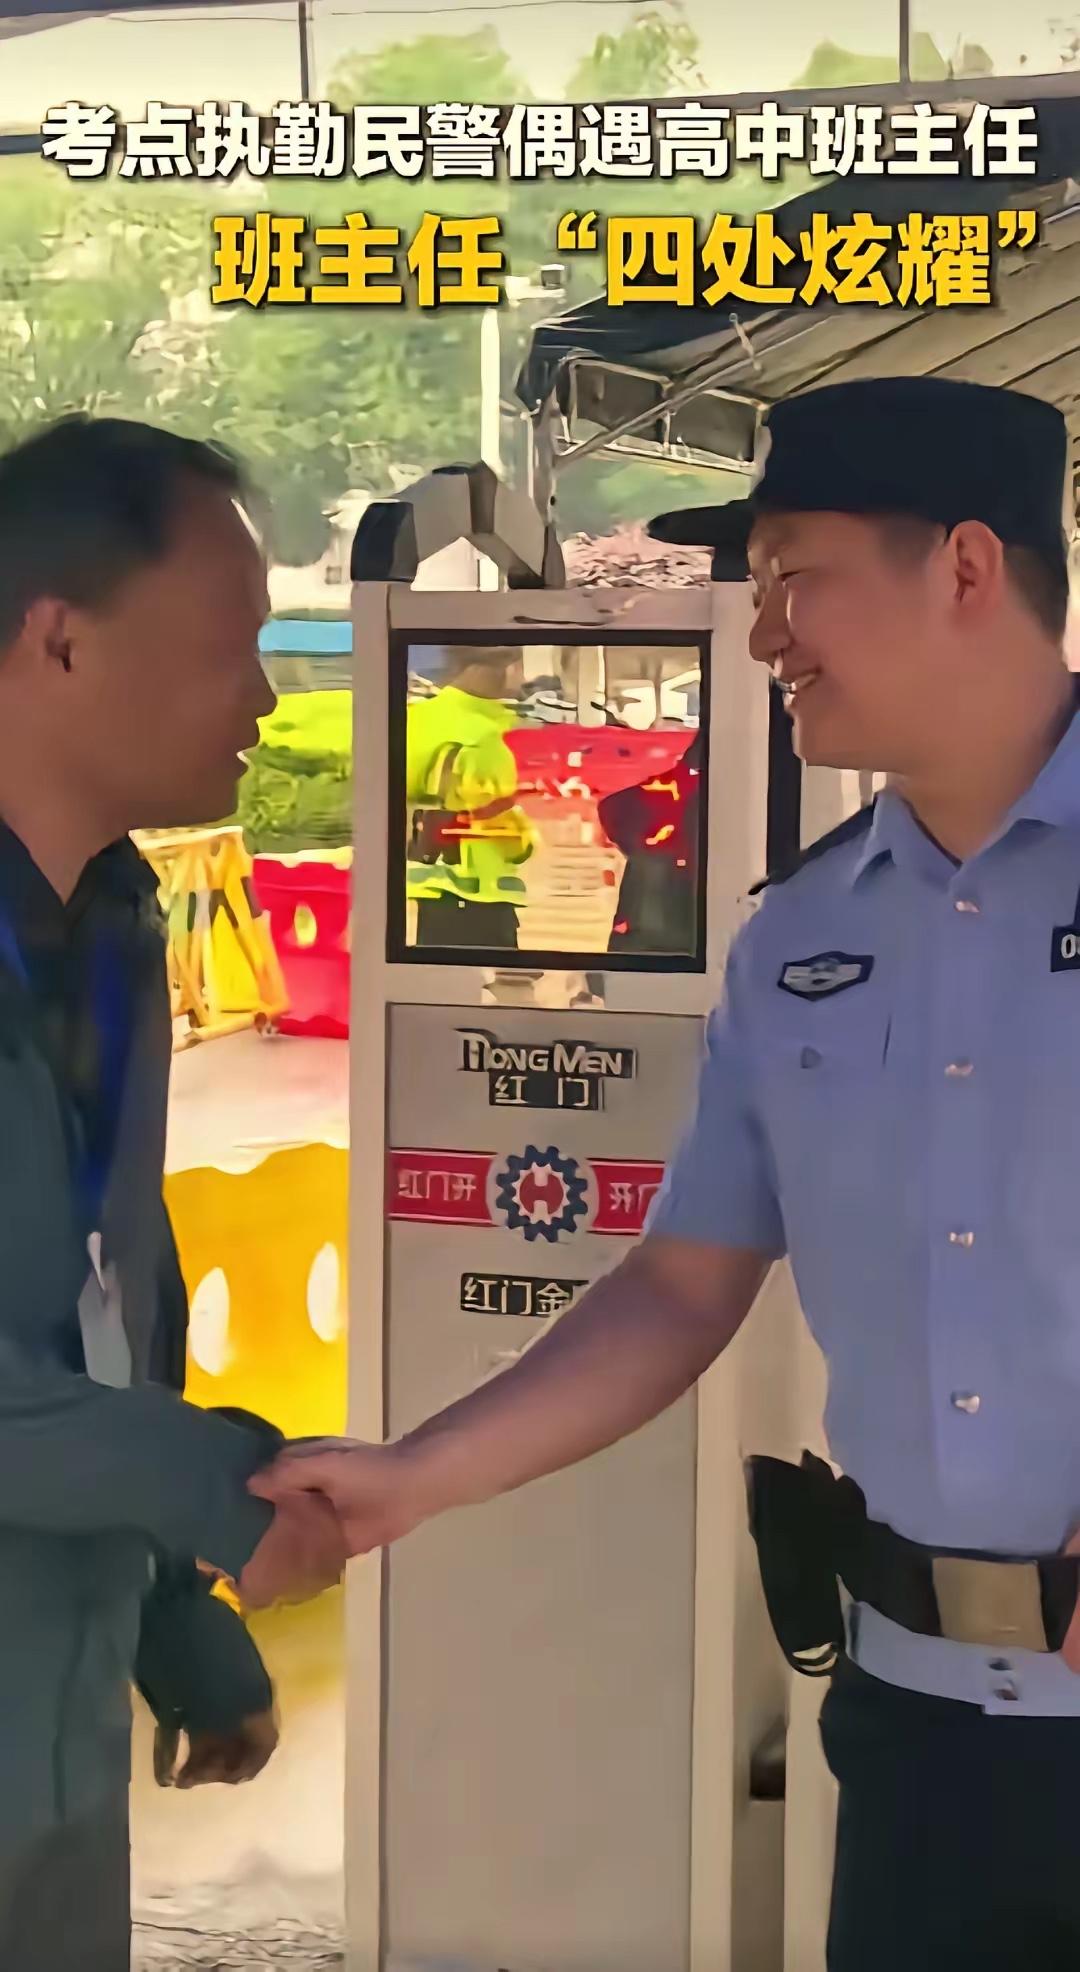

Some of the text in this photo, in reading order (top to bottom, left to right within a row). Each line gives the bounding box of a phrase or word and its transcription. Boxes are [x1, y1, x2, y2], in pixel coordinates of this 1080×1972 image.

[1061, 933, 1080, 959] 0
[462, 1277, 578, 1316] 红门金
